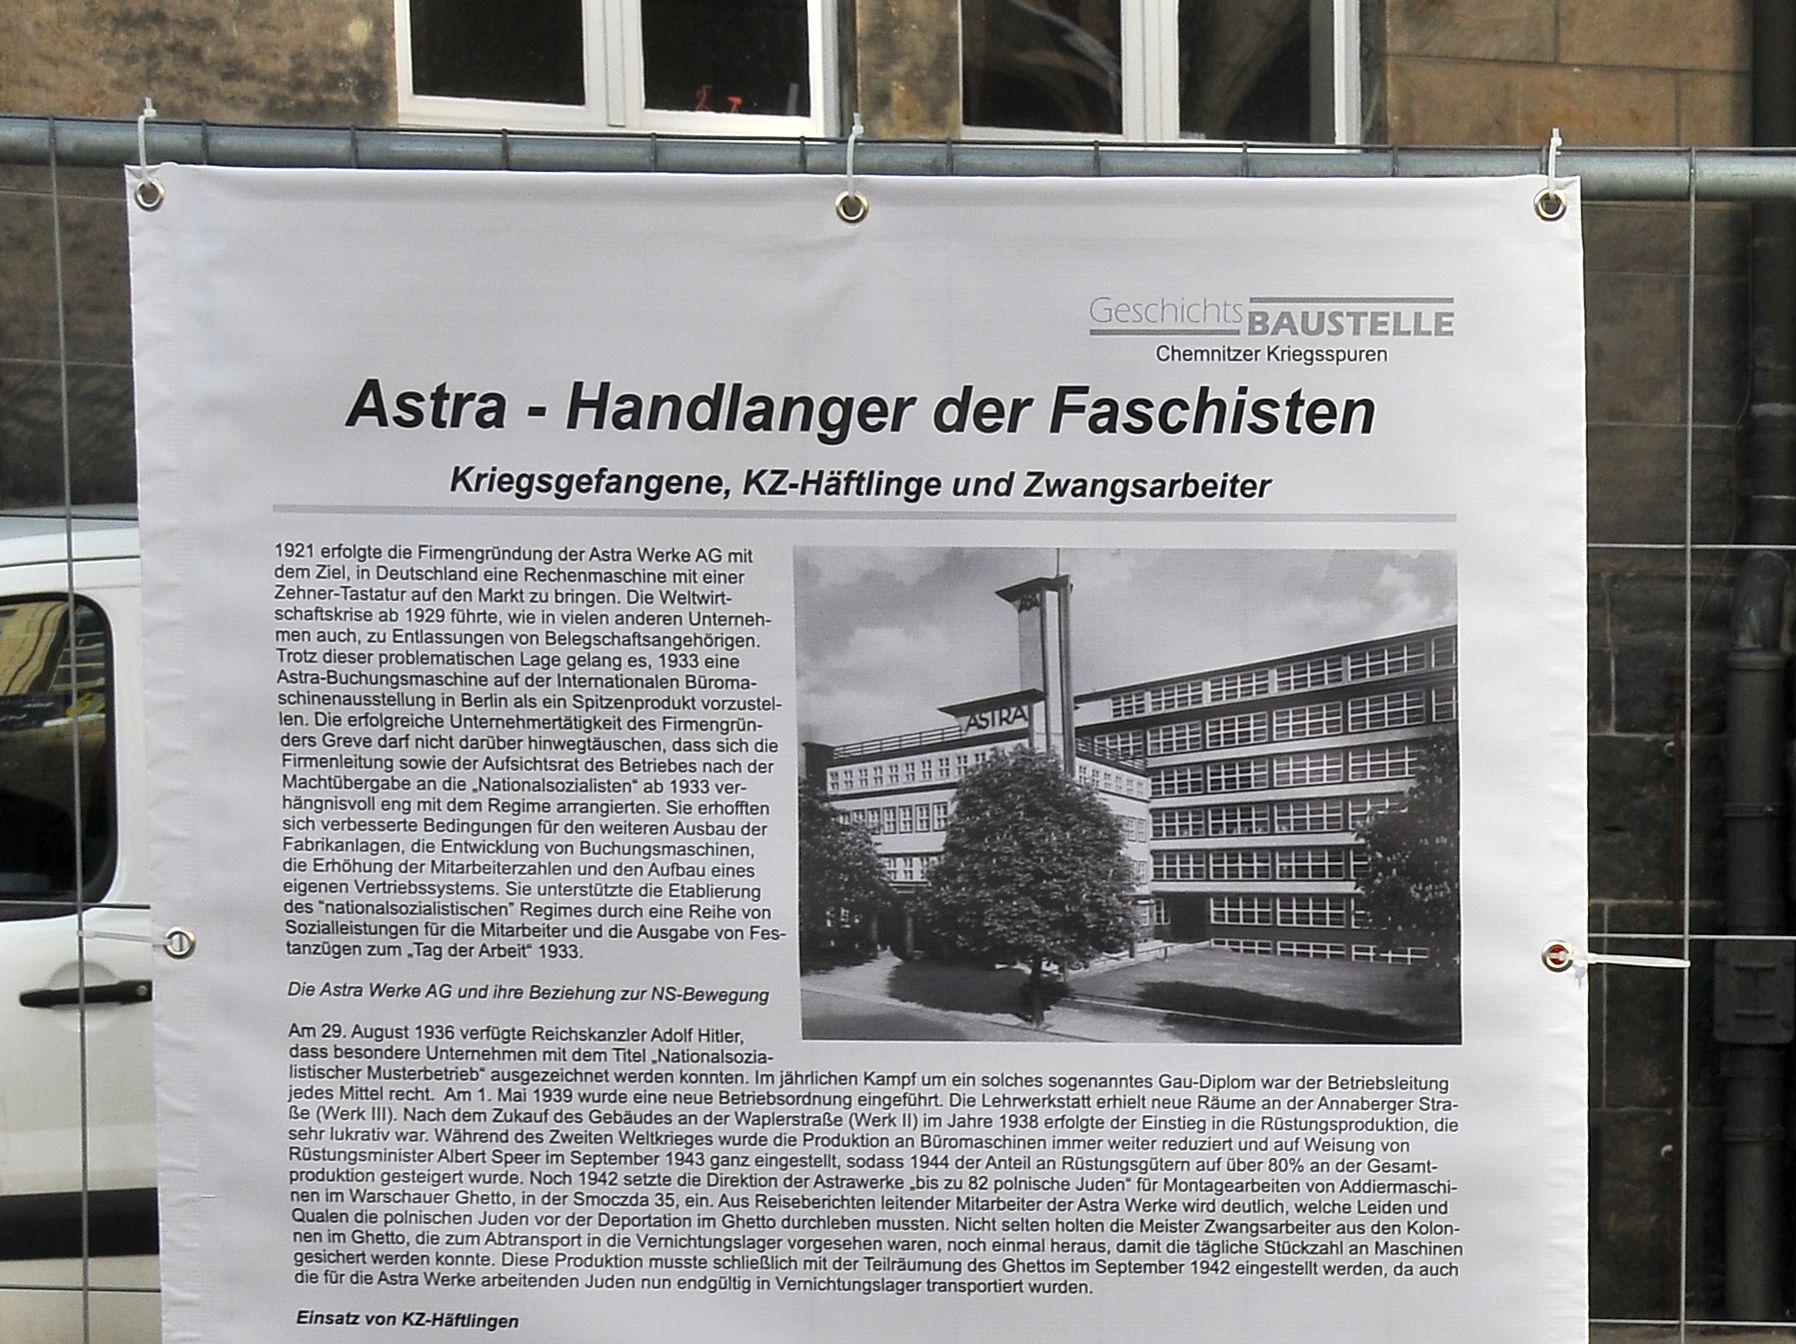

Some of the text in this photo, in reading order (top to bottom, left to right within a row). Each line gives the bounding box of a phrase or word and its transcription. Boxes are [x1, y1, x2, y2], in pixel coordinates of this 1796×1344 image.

[1089, 296, 1455, 337] Geschichts BAUSTELLE
[1156, 344, 1387, 366] Chemnitzer Kriegsspuren
[344, 378, 506, 428] Astra
[566, 381, 917, 445] Handlanger
[933, 384, 1034, 433] der
[1049, 385, 1374, 434] Faschisten
[450, 465, 1273, 504] Kriegsgefangene, KZ-Häftlinge und Zwangsarbeiter
[275, 542, 753, 565] 1921 erfolgte die Firmengründung der Astra Werke AG mit
[965, 704, 1028, 732] ASTRA
[296, 1309, 518, 1331] Einsatz von KZ-Häftlingen
